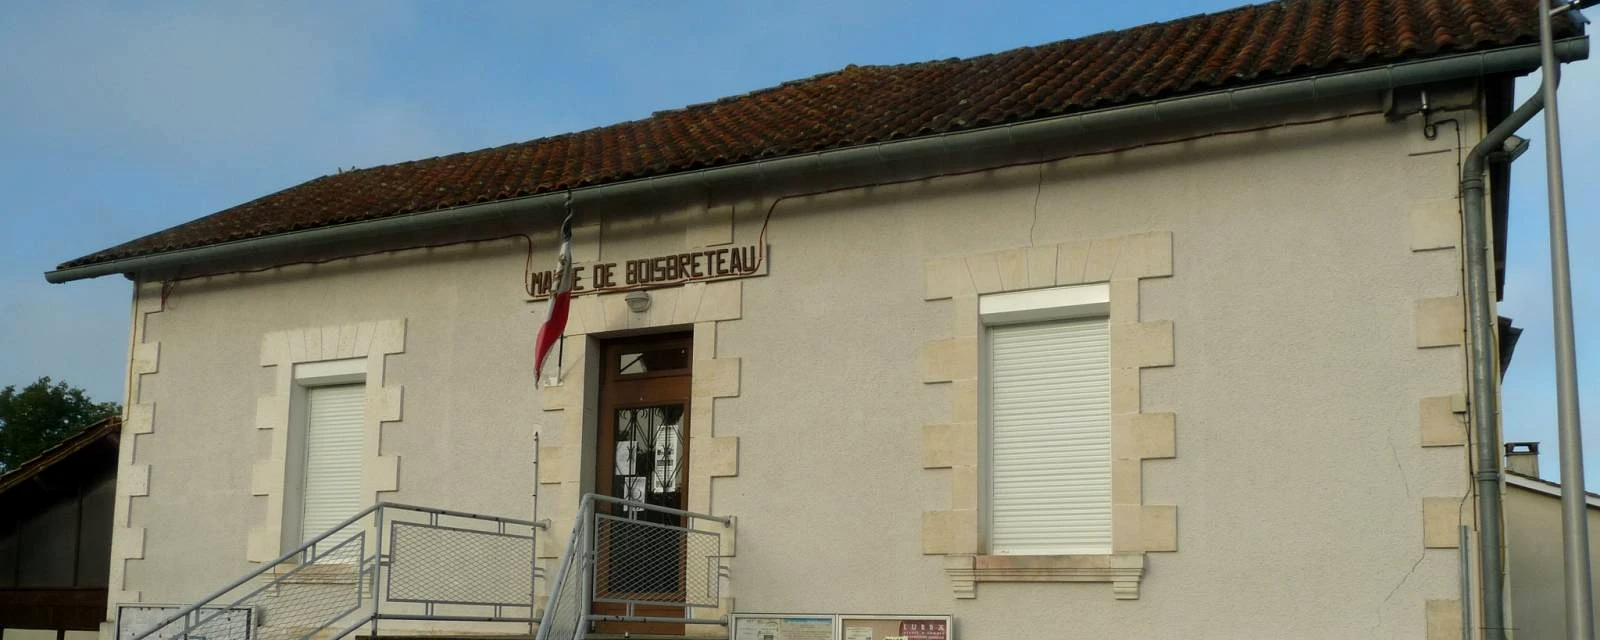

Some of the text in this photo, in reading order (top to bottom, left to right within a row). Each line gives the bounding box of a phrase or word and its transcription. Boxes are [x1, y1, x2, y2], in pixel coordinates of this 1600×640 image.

[531, 245, 756, 296] MAE DE BOISBRETEAU
